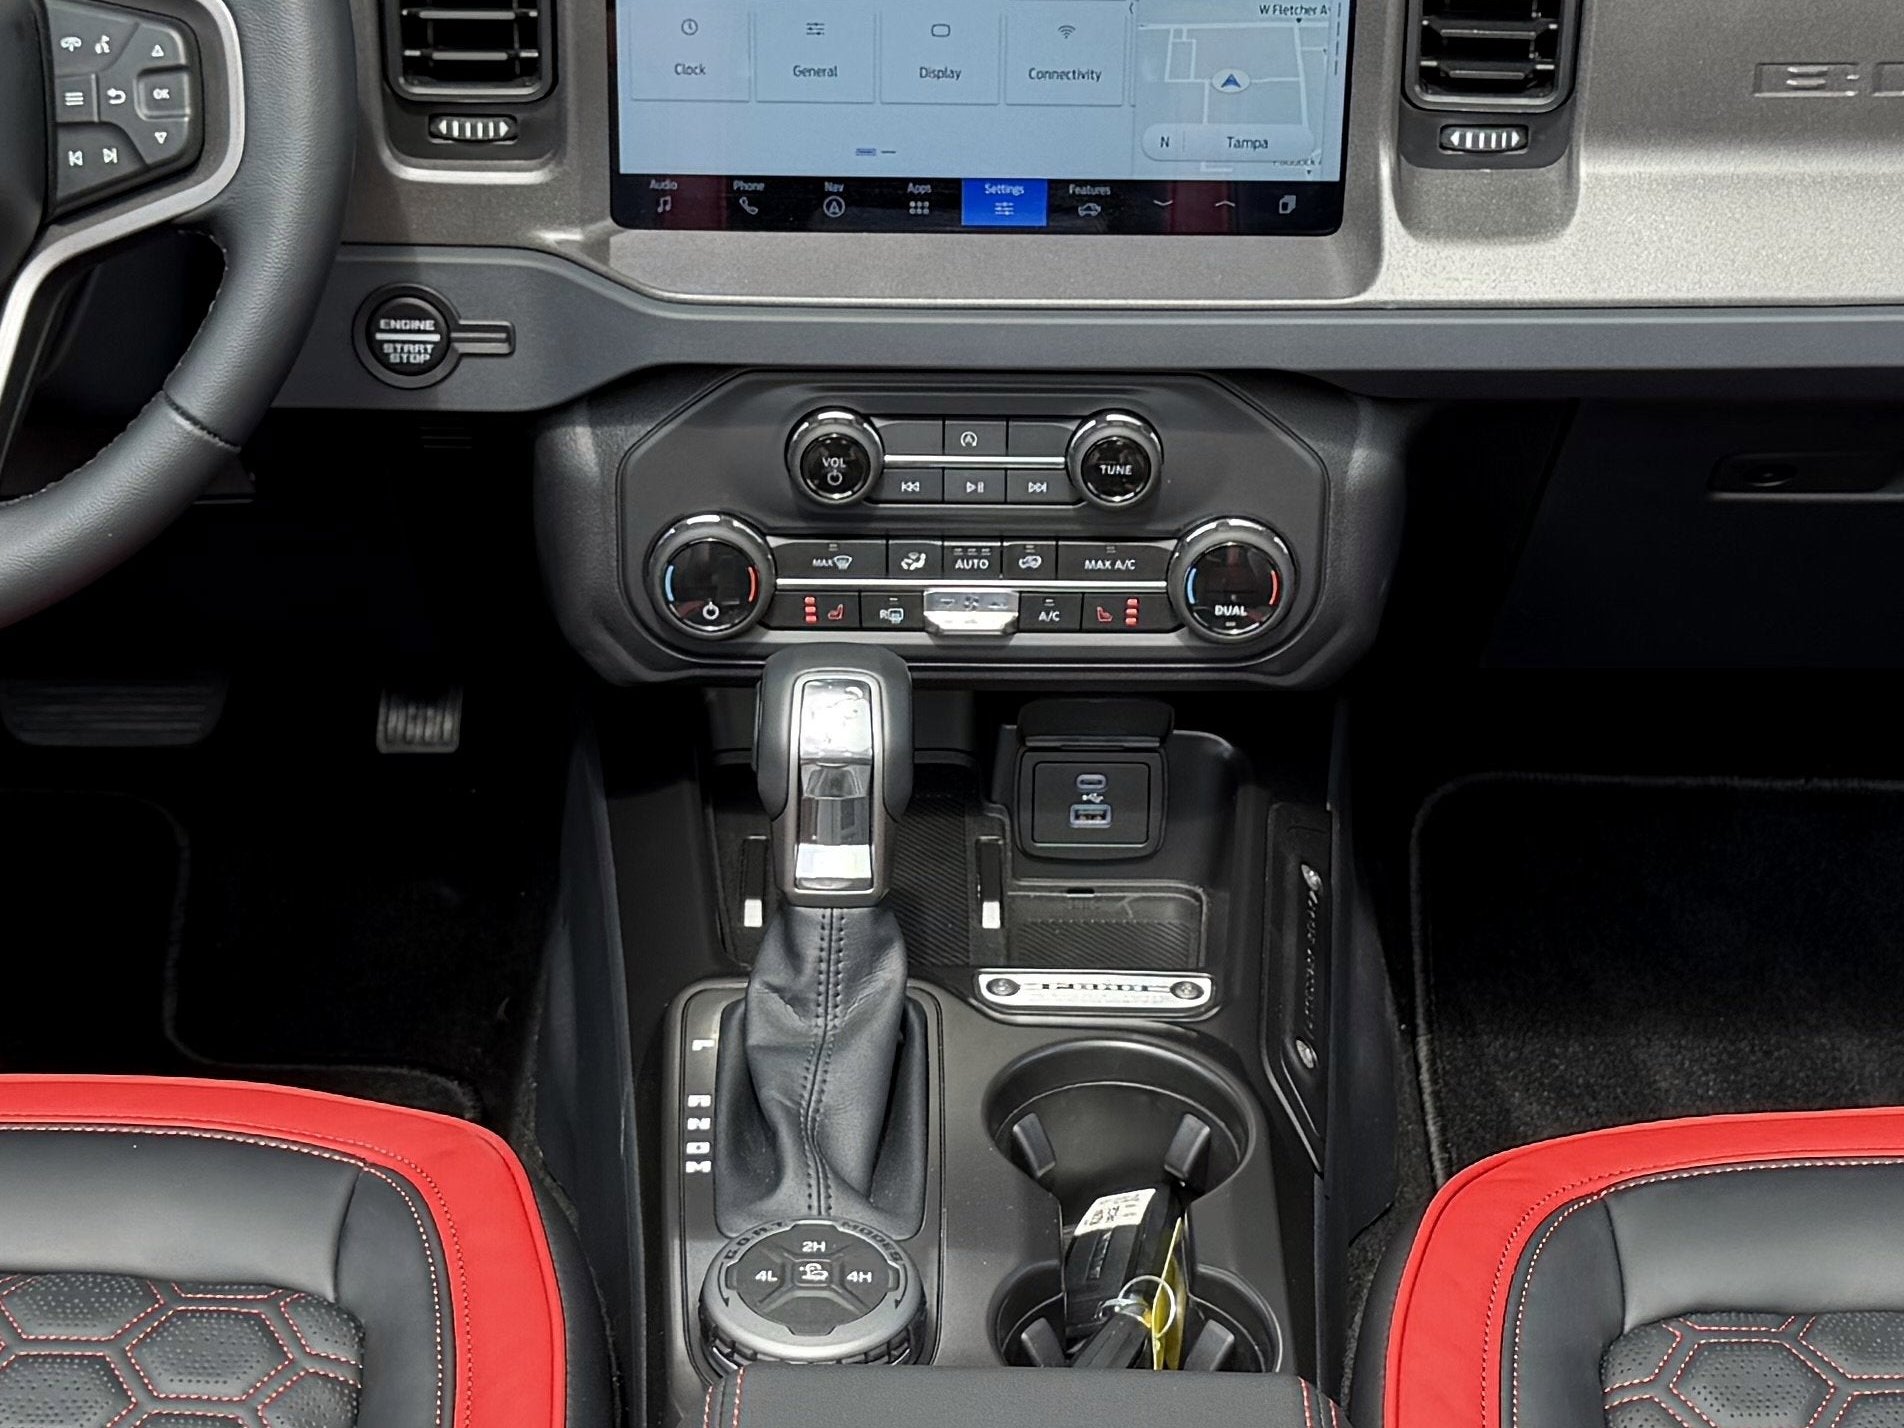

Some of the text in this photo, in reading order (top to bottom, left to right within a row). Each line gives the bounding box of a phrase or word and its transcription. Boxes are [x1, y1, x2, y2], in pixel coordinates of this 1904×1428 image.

[1259, 4, 1270, 15] W
[1272, 4, 1314, 16] Fletcher
[674, 63, 706, 76] Clock
[793, 65, 838, 78] General
[919, 66, 962, 80] Display
[1028, 68, 1102, 82] Connectivity
[1160, 137, 1170, 148] N
[1226, 136, 1269, 150] Tampa
[649, 179, 678, 191] Audio
[733, 180, 766, 192] Phone
[824, 181, 844, 192] Nav
[907, 182, 933, 194] Apps
[984, 184, 1025, 197] Settings
[1068, 184, 1111, 196] Features
[379, 319, 436, 331] ENGINE
[383, 343, 434, 354] START
[389, 353, 431, 364] STOP
[822, 457, 846, 469] VOL
[1099, 463, 1133, 476] TUNE
[812, 557, 834, 569] MAX
[954, 558, 990, 570] AUTO
[1084, 559, 1136, 571] MAX A/C
[1038, 610, 1060, 622] A/C
[1214, 604, 1248, 617] DUAL
[802, 1241, 826, 1253] 2H
[754, 1270, 779, 1282] 4L
[846, 1271, 873, 1283] 4H
